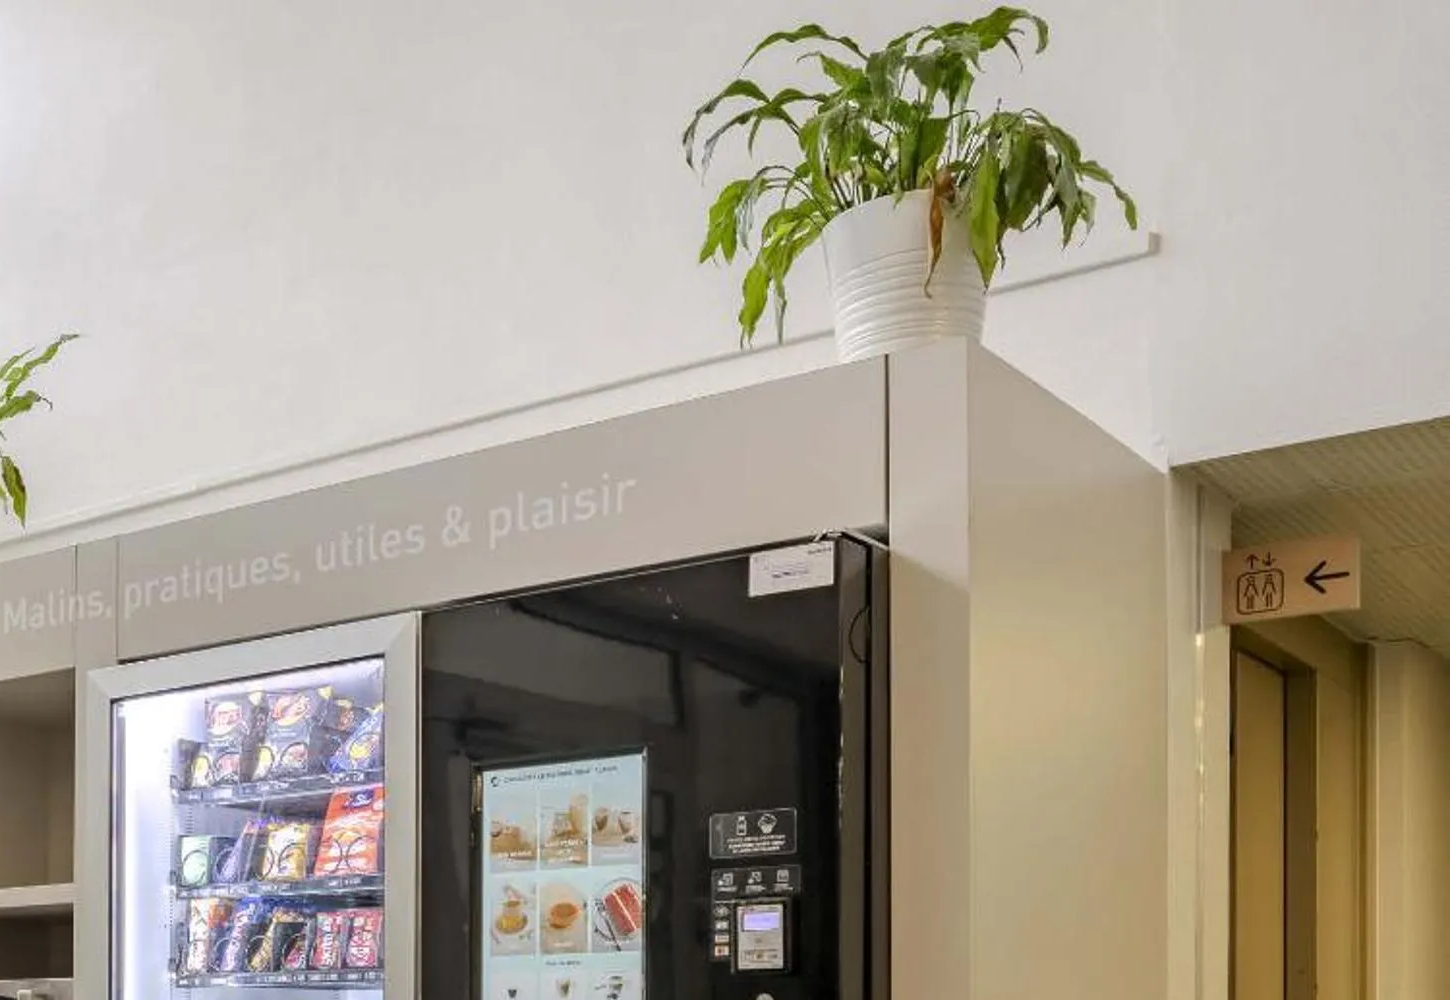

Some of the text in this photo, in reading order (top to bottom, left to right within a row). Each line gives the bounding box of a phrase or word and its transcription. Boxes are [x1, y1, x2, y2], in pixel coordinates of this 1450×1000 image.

[3, 472, 637, 634] Malins, pratiques, utiles & plaisir
